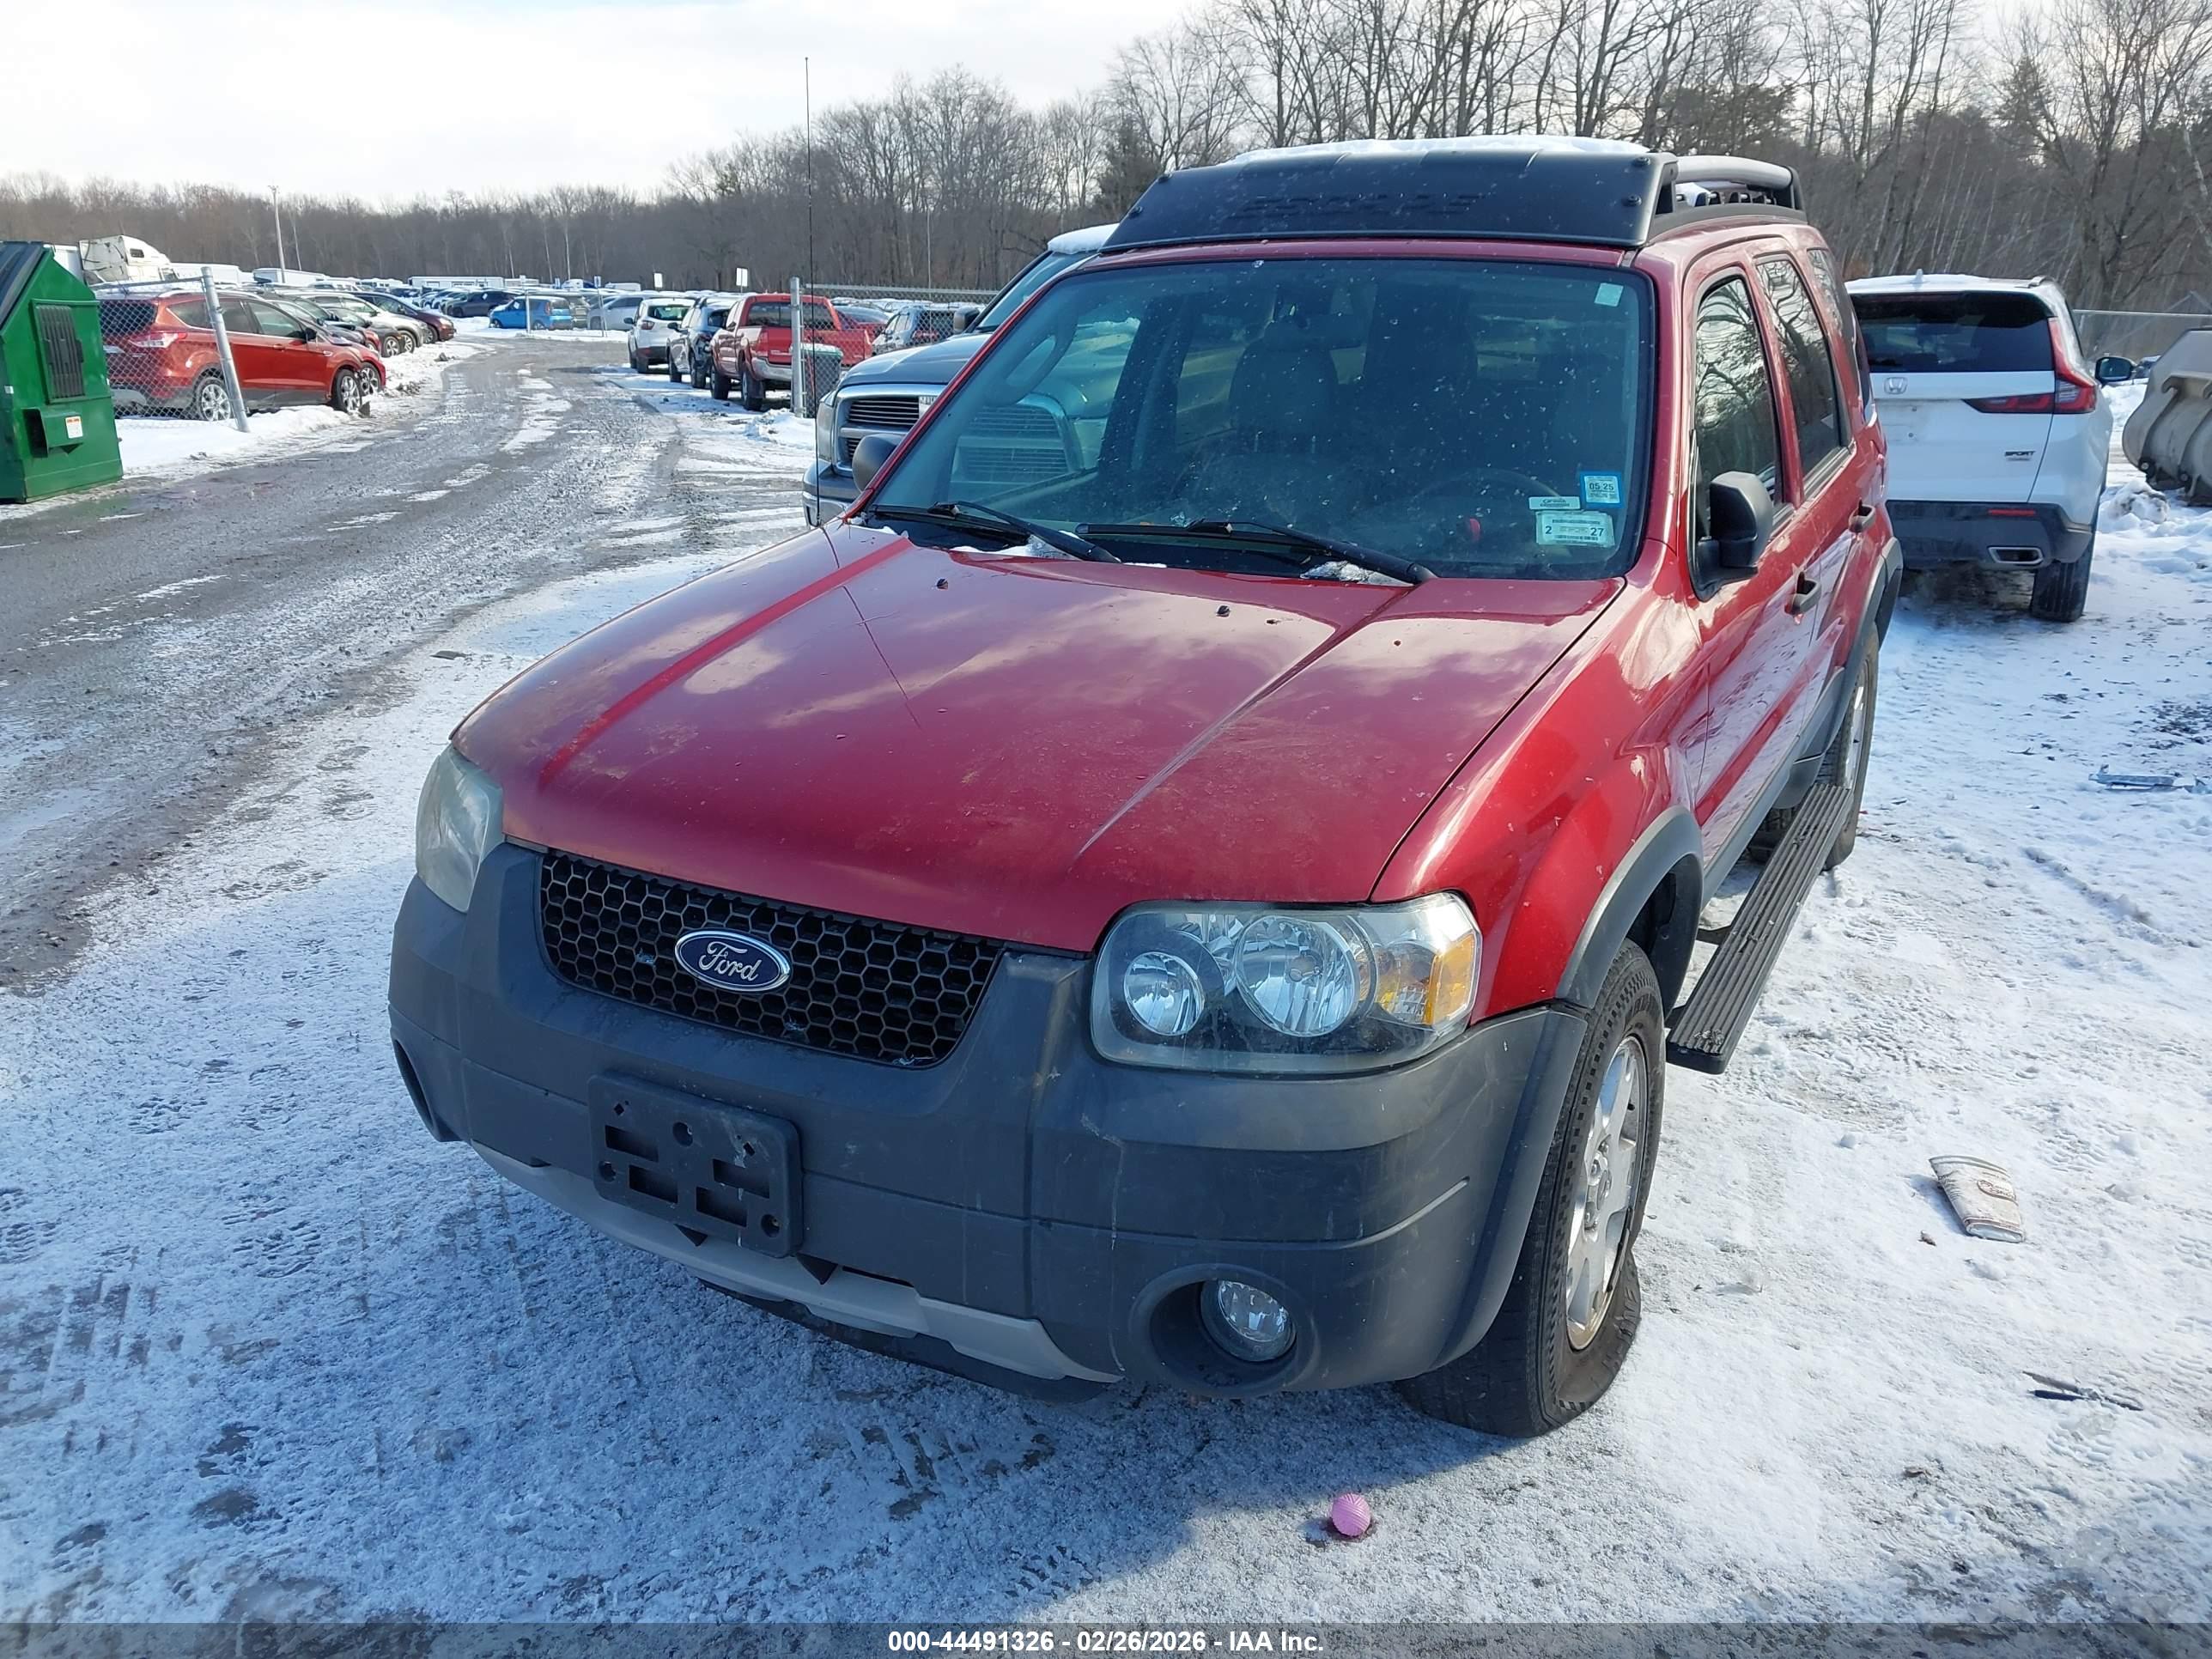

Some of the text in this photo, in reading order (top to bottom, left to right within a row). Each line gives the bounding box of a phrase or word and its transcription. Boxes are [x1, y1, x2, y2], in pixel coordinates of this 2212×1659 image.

[1545, 526, 1553, 534] 2
[1589, 527, 1604, 537] 27
[698, 941, 763, 981] Ford
